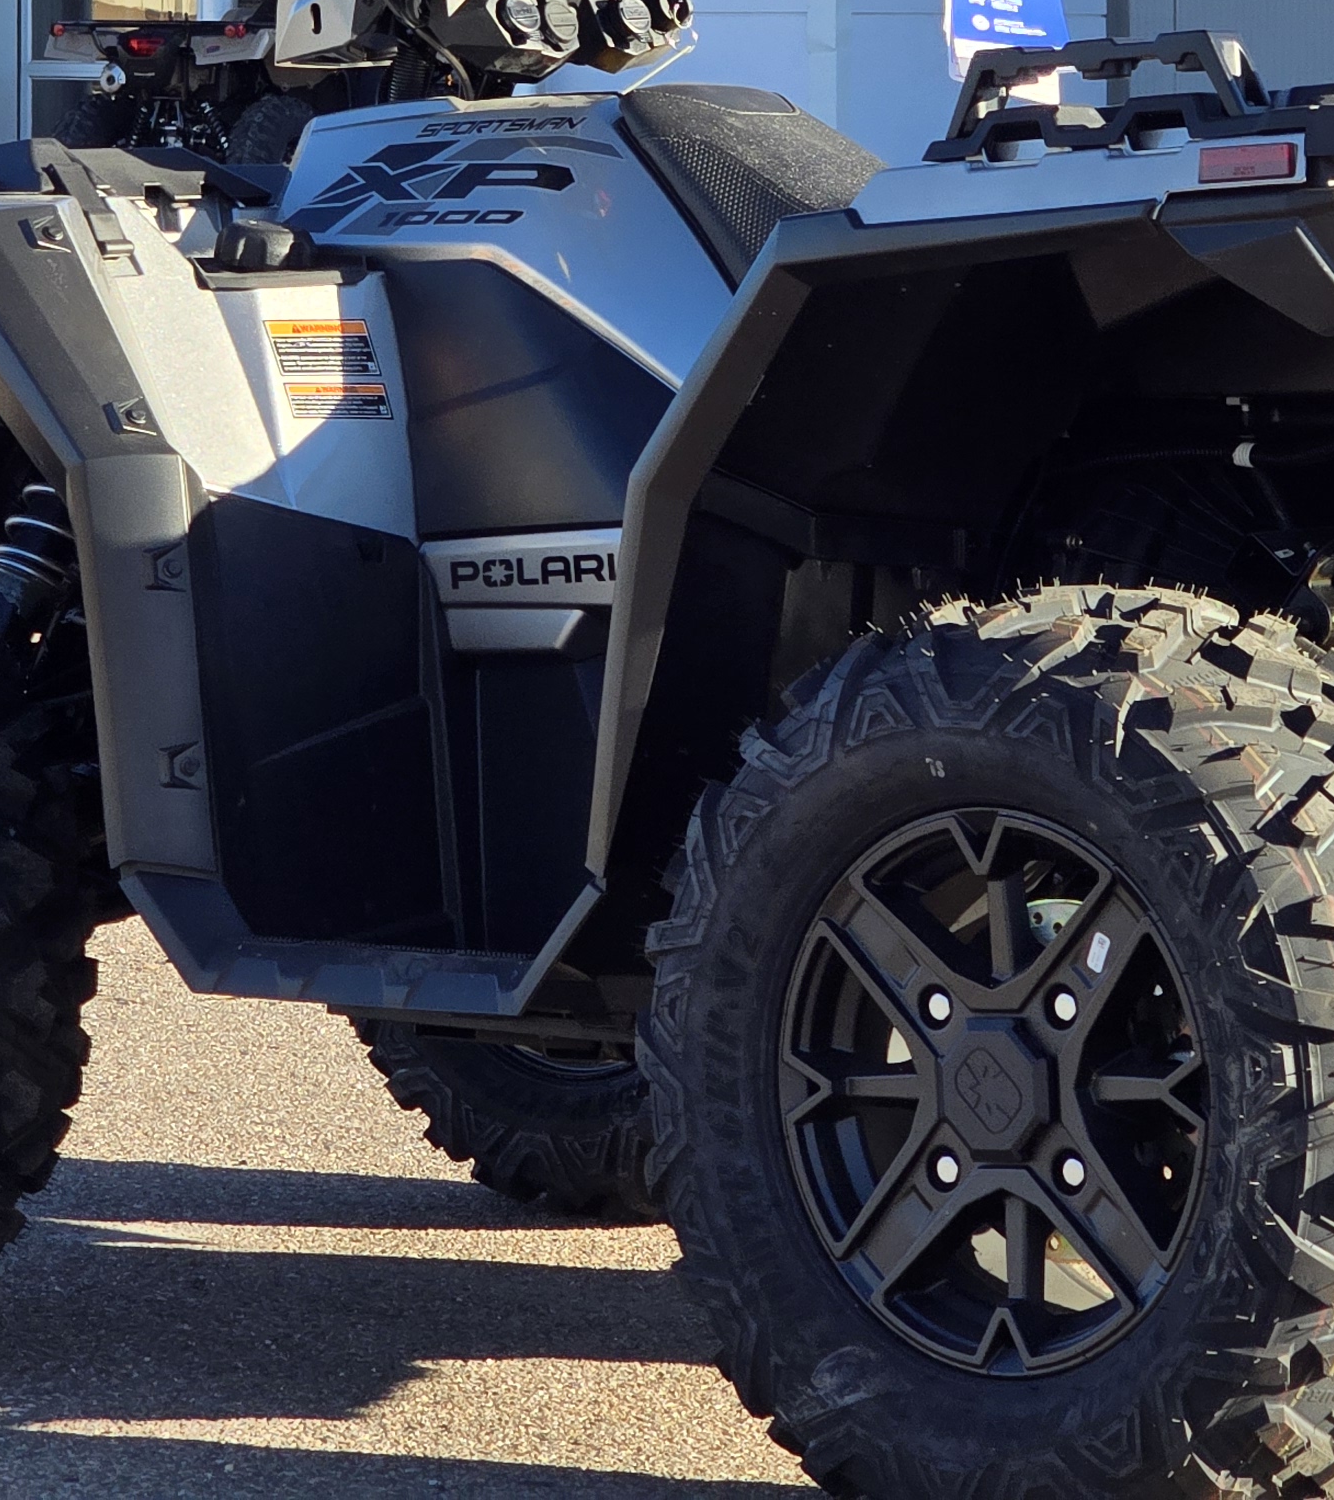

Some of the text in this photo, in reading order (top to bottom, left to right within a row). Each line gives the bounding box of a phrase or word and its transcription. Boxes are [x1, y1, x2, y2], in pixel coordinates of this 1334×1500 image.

[416, 116, 588, 138] SPORTSMAN
[307, 143, 575, 202] XP
[378, 209, 524, 227] 1000
[449, 553, 617, 590] POLARI
